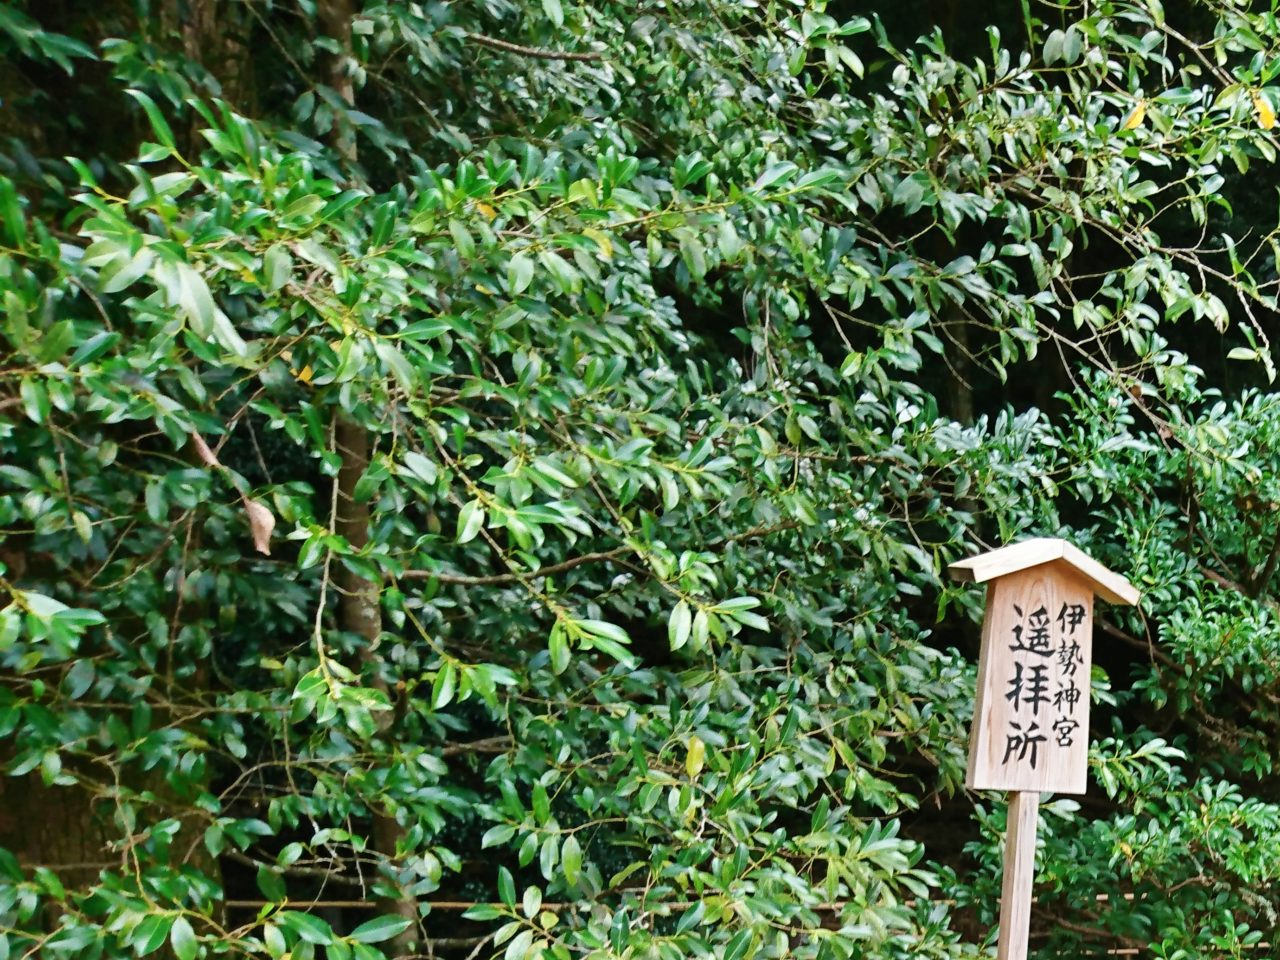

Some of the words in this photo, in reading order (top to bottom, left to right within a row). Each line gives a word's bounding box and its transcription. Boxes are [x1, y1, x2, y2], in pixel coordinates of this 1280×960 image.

[1002, 604, 1056, 769] 遥拝所
[1052, 602, 1086, 747] 伊勢神宮
